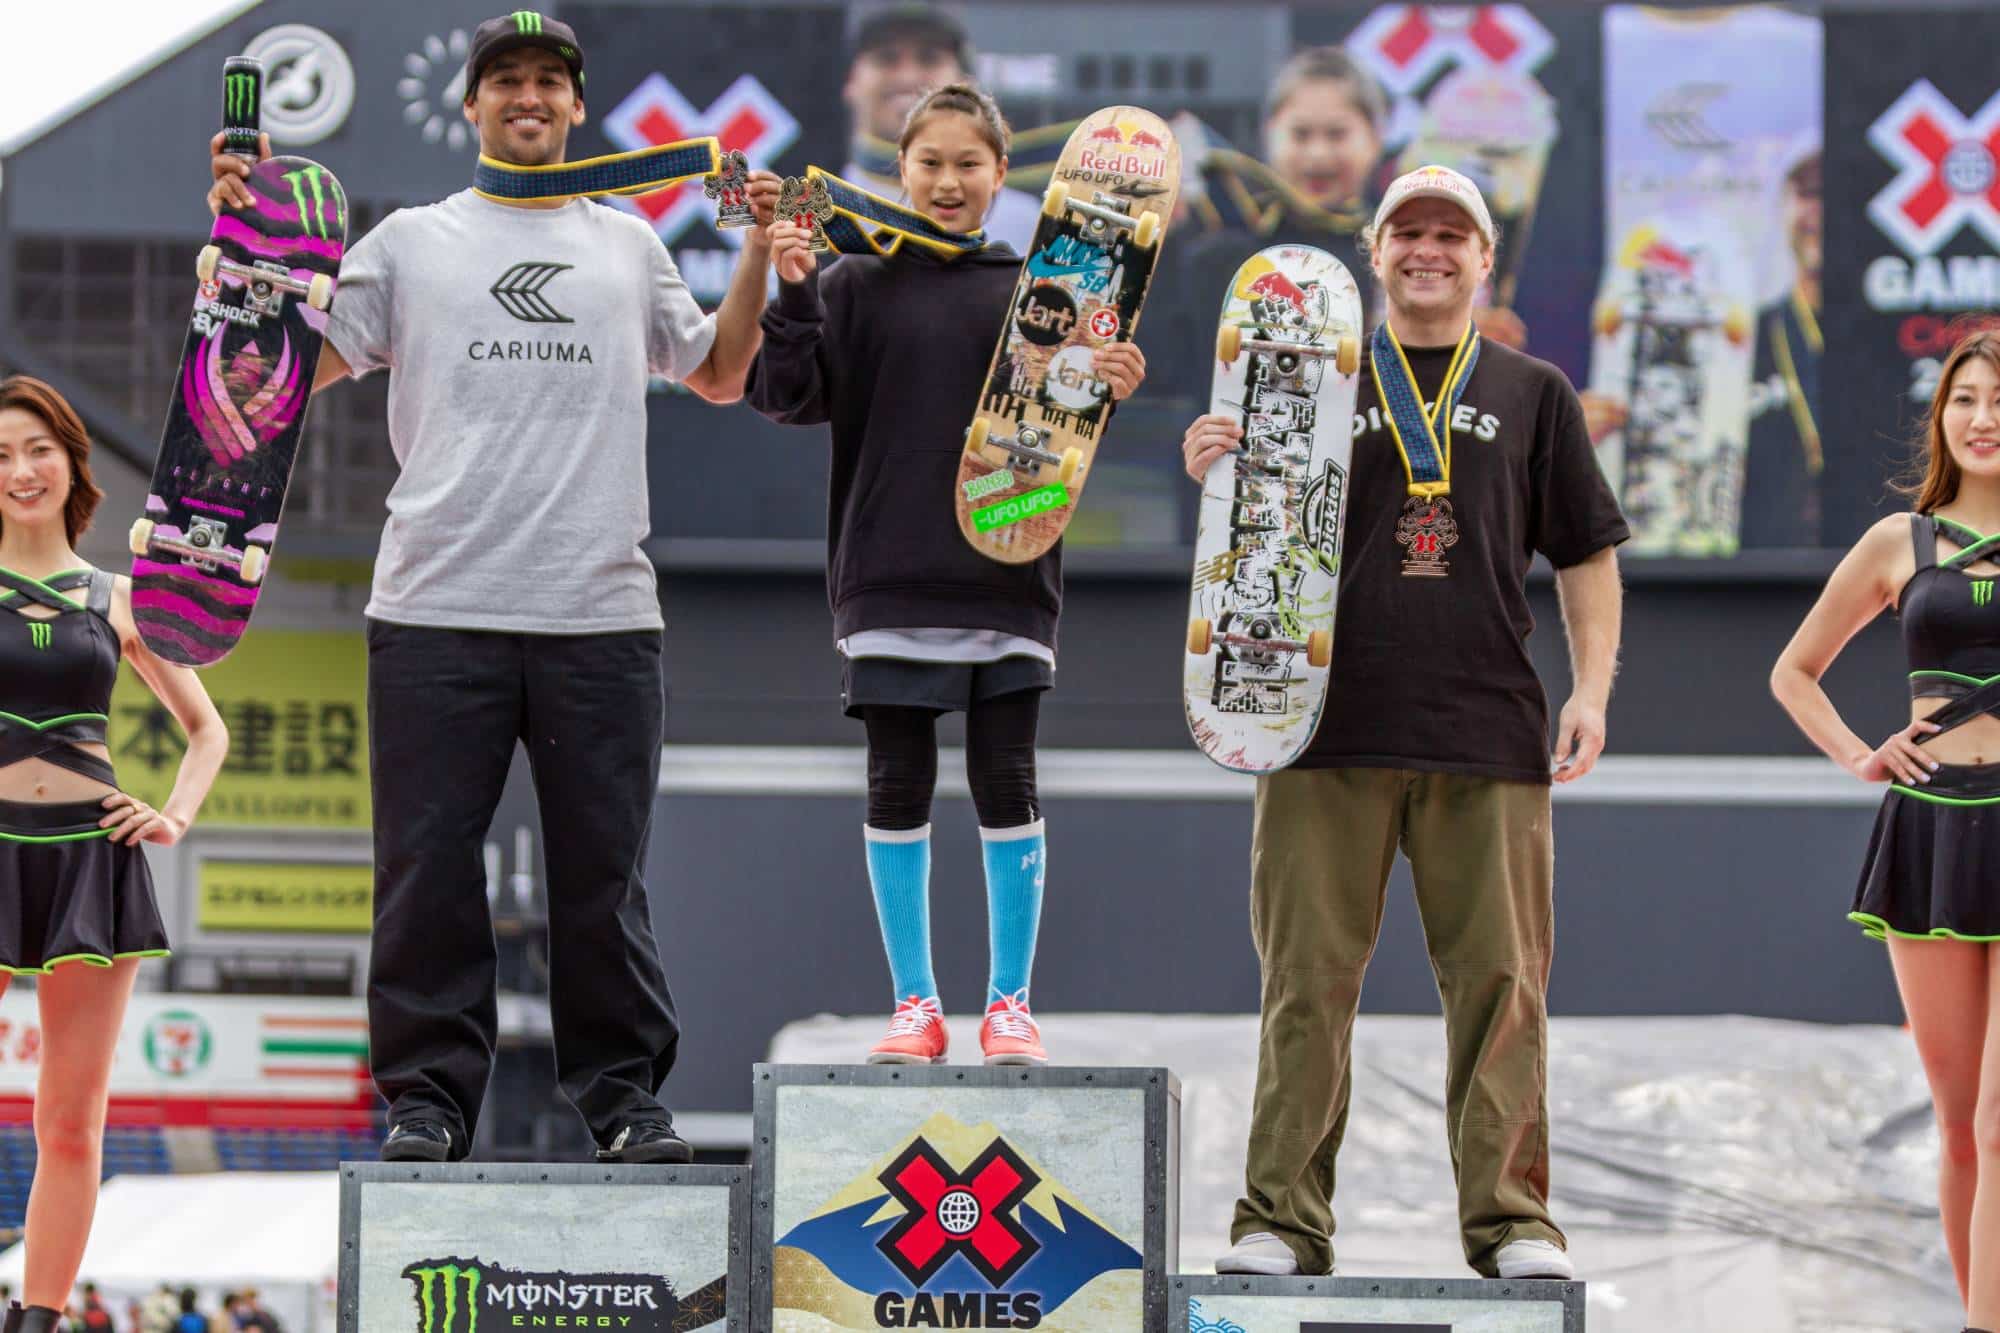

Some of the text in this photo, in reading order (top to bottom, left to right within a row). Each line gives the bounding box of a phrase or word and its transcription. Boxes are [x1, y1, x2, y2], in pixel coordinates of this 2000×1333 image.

[1080, 150, 1165, 177] Red Bull
[1095, 172, 1124, 185] UFO
[1078, 273, 1108, 292] SB
[1015, 296, 1073, 335] Jart
[468, 341, 593, 364] CARIUMA
[1320, 473, 1340, 560] Dickies
[512, 1315, 631, 1326] ENERGY
[874, 1291, 1042, 1329] GAMES
